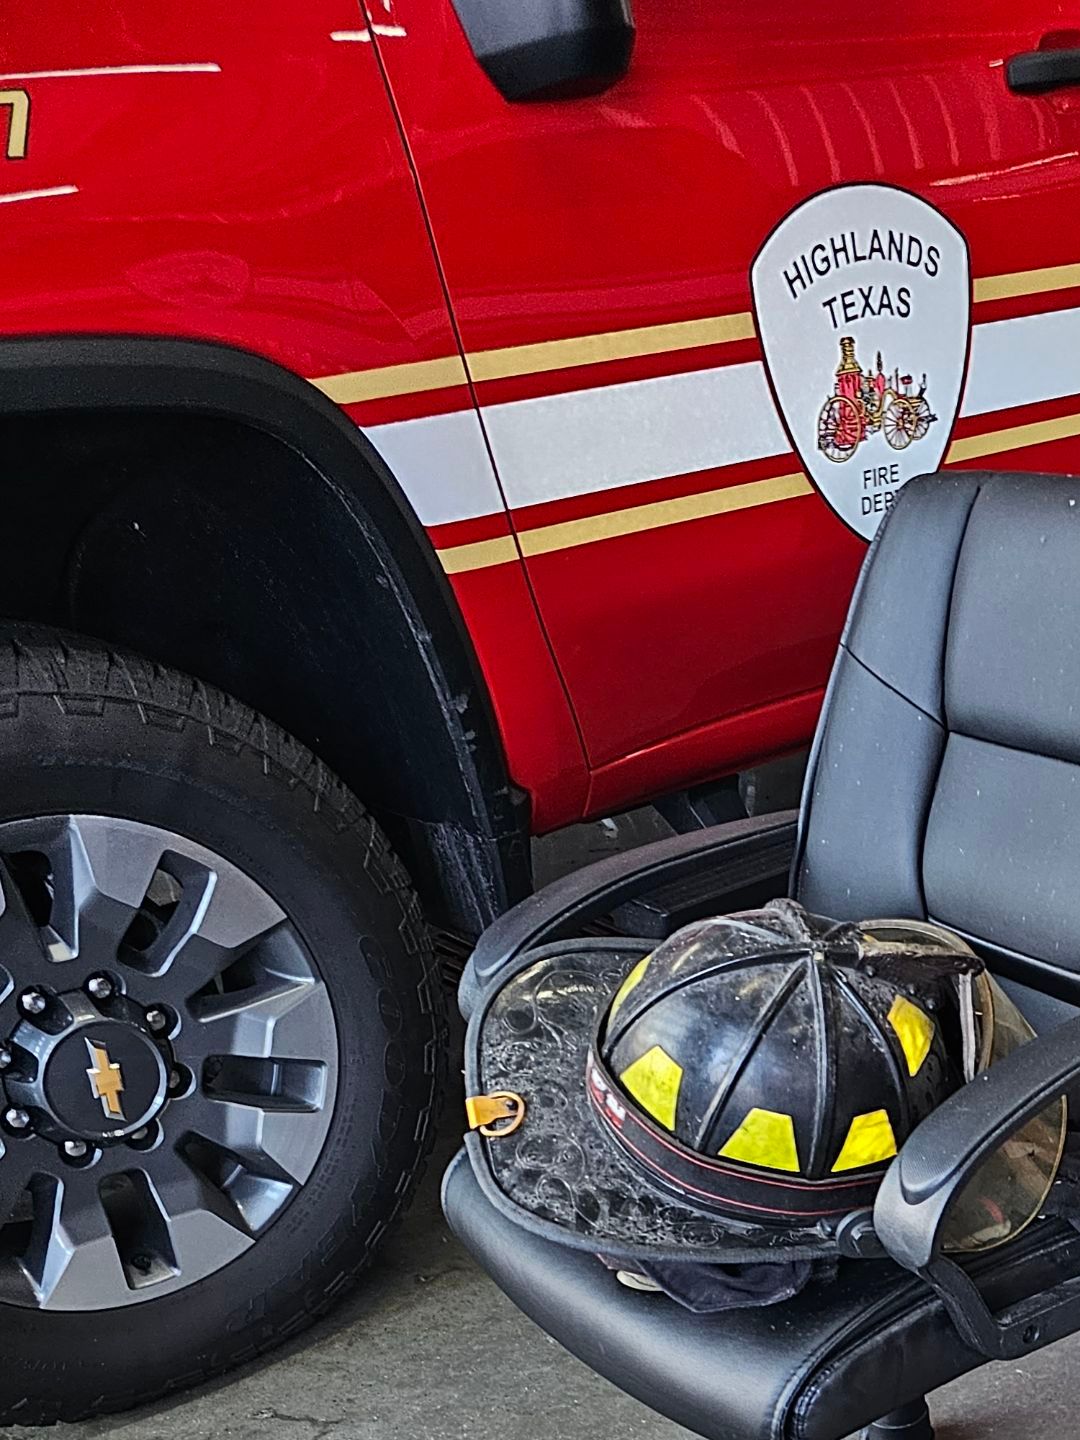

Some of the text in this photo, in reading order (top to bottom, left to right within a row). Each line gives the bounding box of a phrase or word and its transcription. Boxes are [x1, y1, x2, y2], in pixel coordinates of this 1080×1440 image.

[782, 229, 941, 299] HIGHLANDS
[822, 285, 912, 329] TEXAS
[863, 463, 900, 489] FIRE
